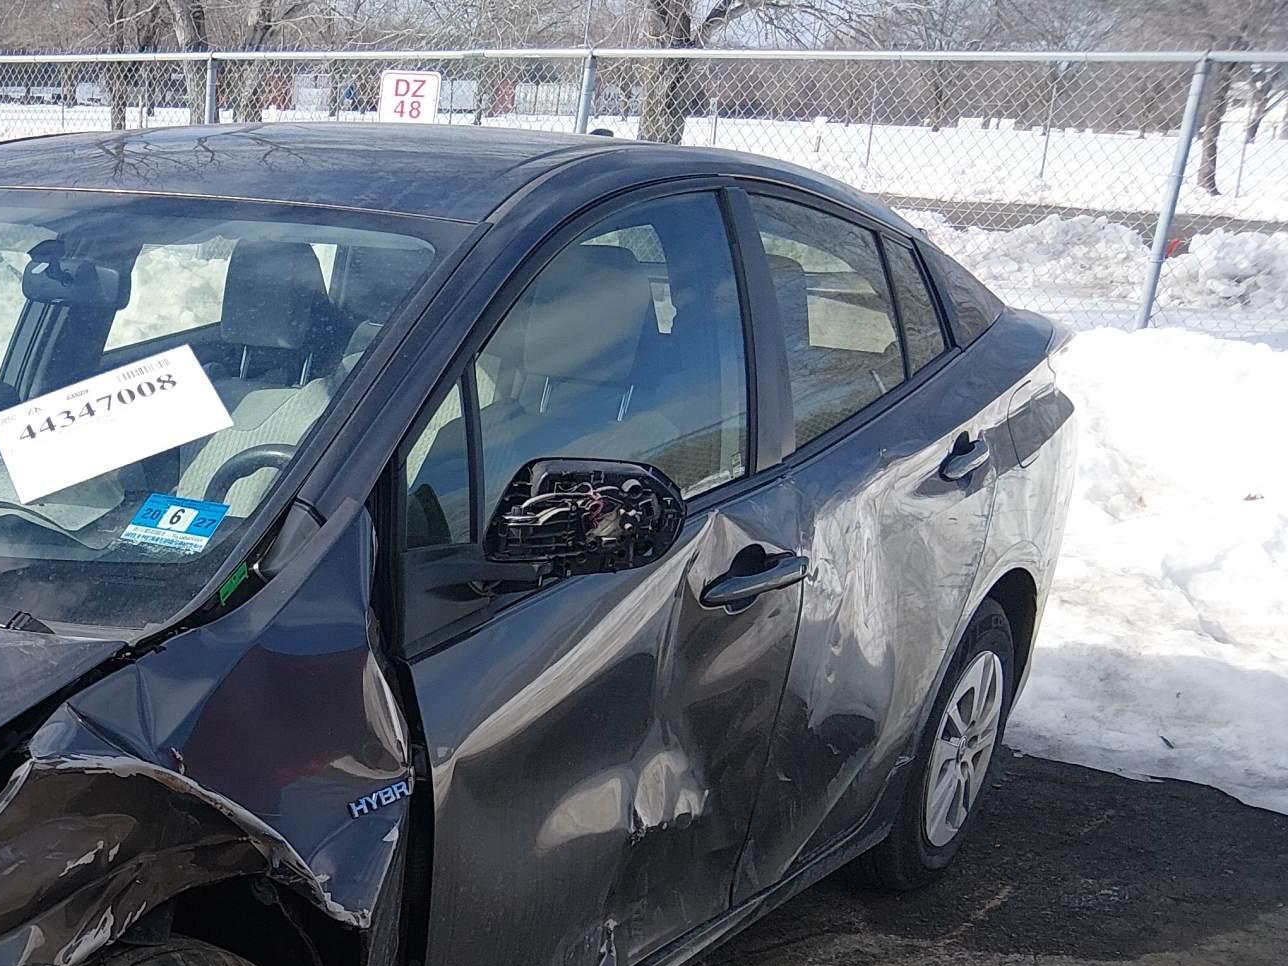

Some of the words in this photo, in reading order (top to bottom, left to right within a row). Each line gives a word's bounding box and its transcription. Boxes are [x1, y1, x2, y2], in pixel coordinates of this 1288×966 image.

[394, 78, 426, 98] DZ
[393, 100, 422, 119] 48
[18, 373, 178, 441] 44347008
[141, 507, 162, 520] 20
[168, 508, 186, 526] 6
[192, 517, 217, 529] 27
